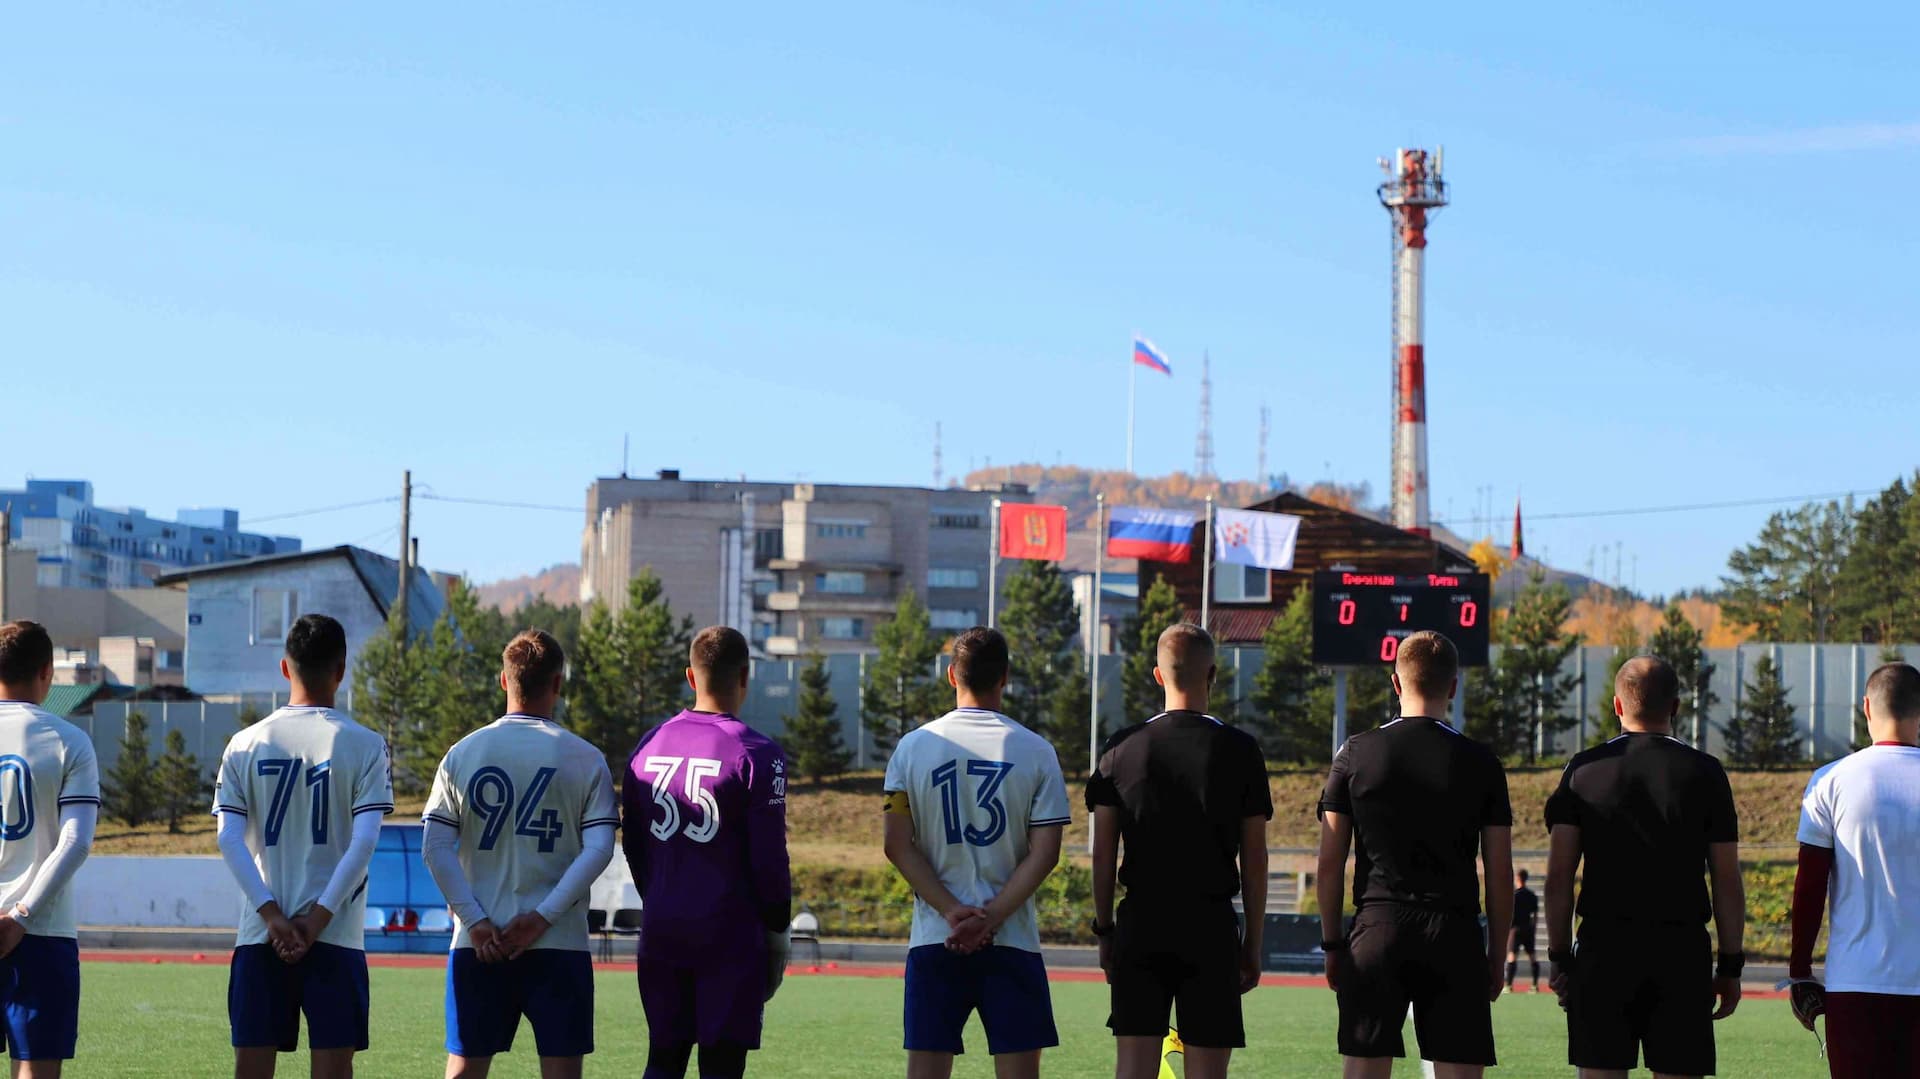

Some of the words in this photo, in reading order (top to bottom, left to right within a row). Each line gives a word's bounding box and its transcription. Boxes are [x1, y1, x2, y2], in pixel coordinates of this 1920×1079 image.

[1338, 599, 1356, 625] 0
[1400, 603, 1408, 622] 1
[1459, 601, 1477, 627] 0
[1380, 635, 1398, 661] 0
[258, 758, 331, 847] 71
[469, 766, 564, 853] 94
[643, 756, 722, 843] 35
[932, 759, 1015, 847] 13
